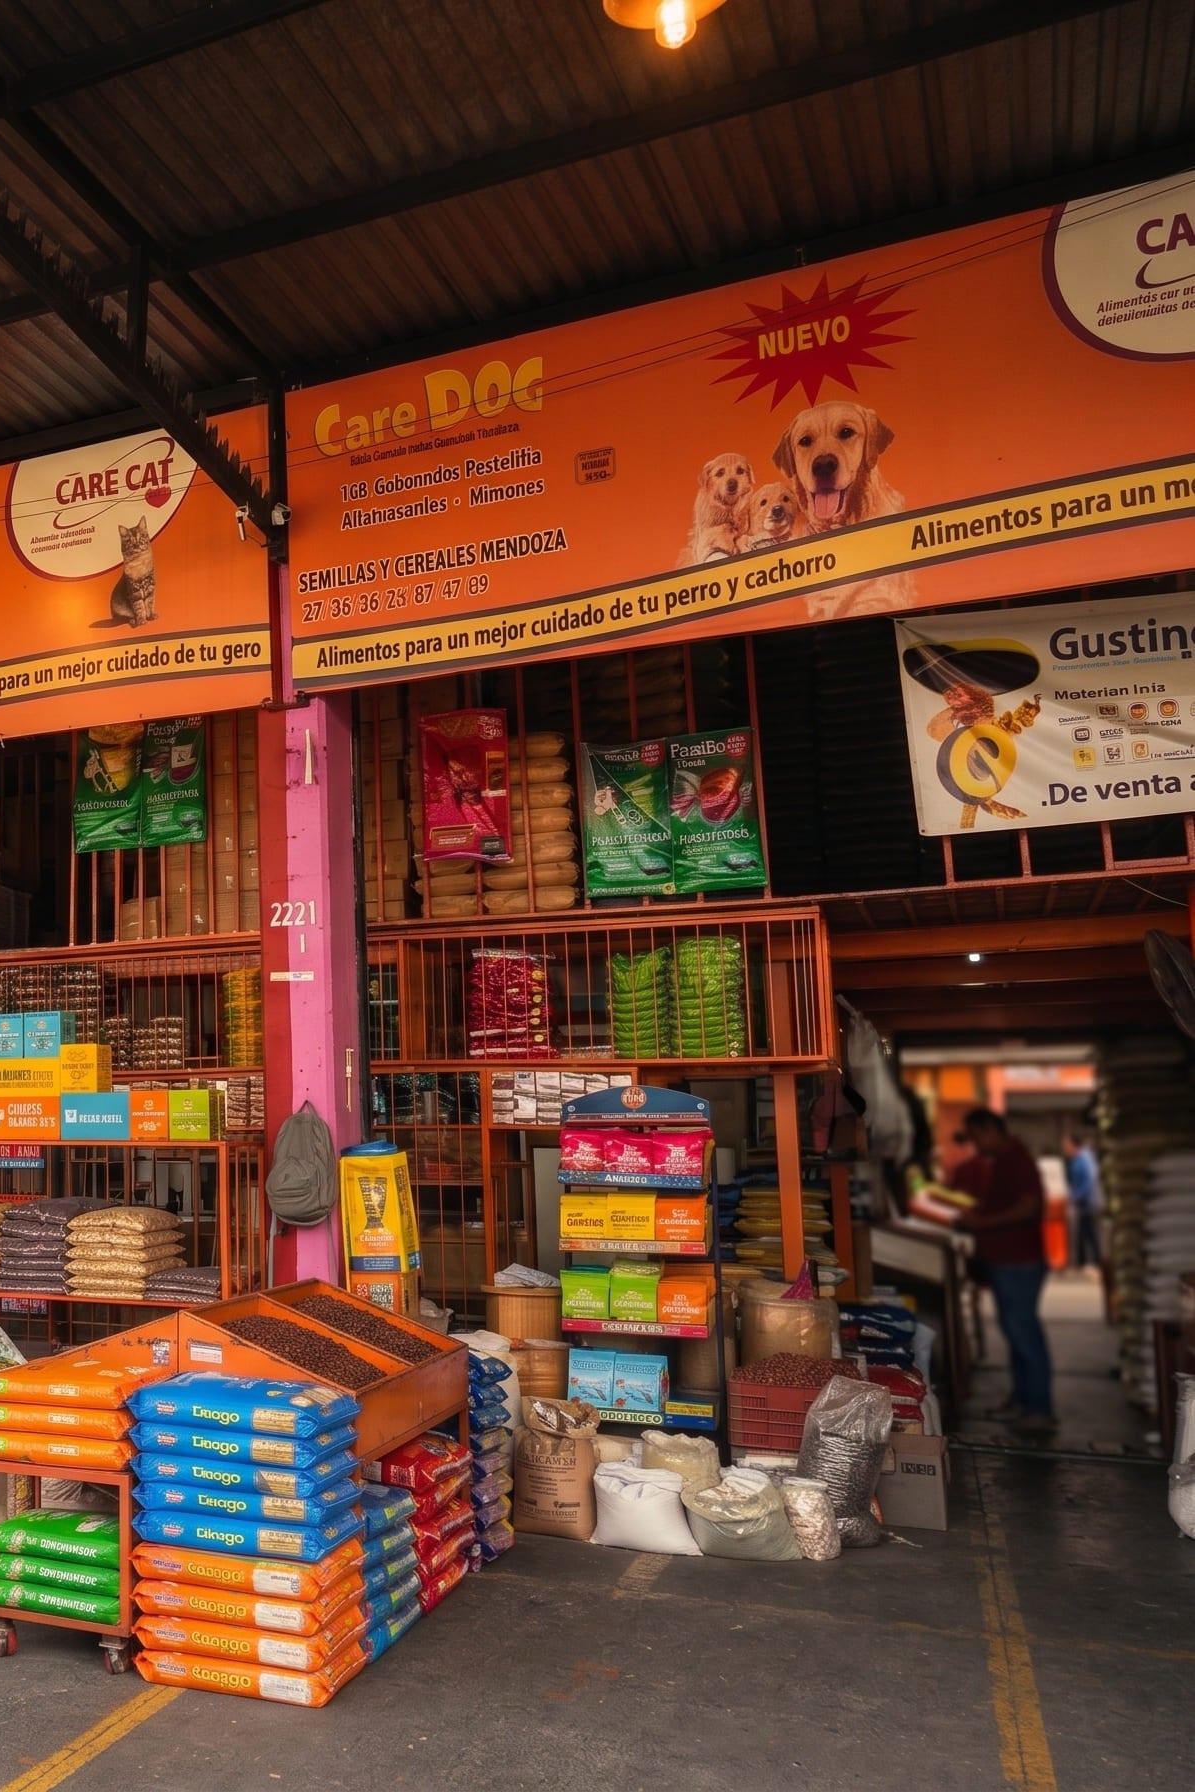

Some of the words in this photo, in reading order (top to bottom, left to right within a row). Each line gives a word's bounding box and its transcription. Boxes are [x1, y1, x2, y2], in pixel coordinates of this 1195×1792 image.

[758, 315, 850, 359] NUEVO
[314, 402, 416, 457] Care
[423, 356, 543, 433] DOG
[55, 468, 120, 505] CARE
[125, 457, 174, 491] CAT
[470, 478, 544, 507] Mimones
[299, 561, 376, 593] SEMILLAS
[379, 558, 390, 580] Y
[394, 544, 476, 577] CEREALES
[479, 527, 567, 563] MENDOZA
[316, 641, 401, 669] Alimentos
[405, 634, 442, 662] para
[447, 631, 469, 650] un
[474, 620, 526, 647] mejor
[531, 603, 605, 637] cuidado
[609, 598, 633, 621] de
[637, 594, 659, 614] tu
[665, 581, 721, 615] perro
[726, 576, 739, 601] y
[744, 552, 836, 589] cachorro
[910, 506, 1043, 551] Alimentos
[1050, 493, 1112, 528] para
[1120, 484, 1156, 508] un
[1163, 477, 1195, 501] m
[34, 665, 54, 684] un
[57, 655, 103, 683] mejor
[107, 645, 170, 673] cuidado
[174, 642, 196, 664] de
[199, 641, 217, 661] tu
[222, 640, 261, 666] gero
[1094, 774, 1182, 801] venta
[270, 901, 316, 927] 2221
